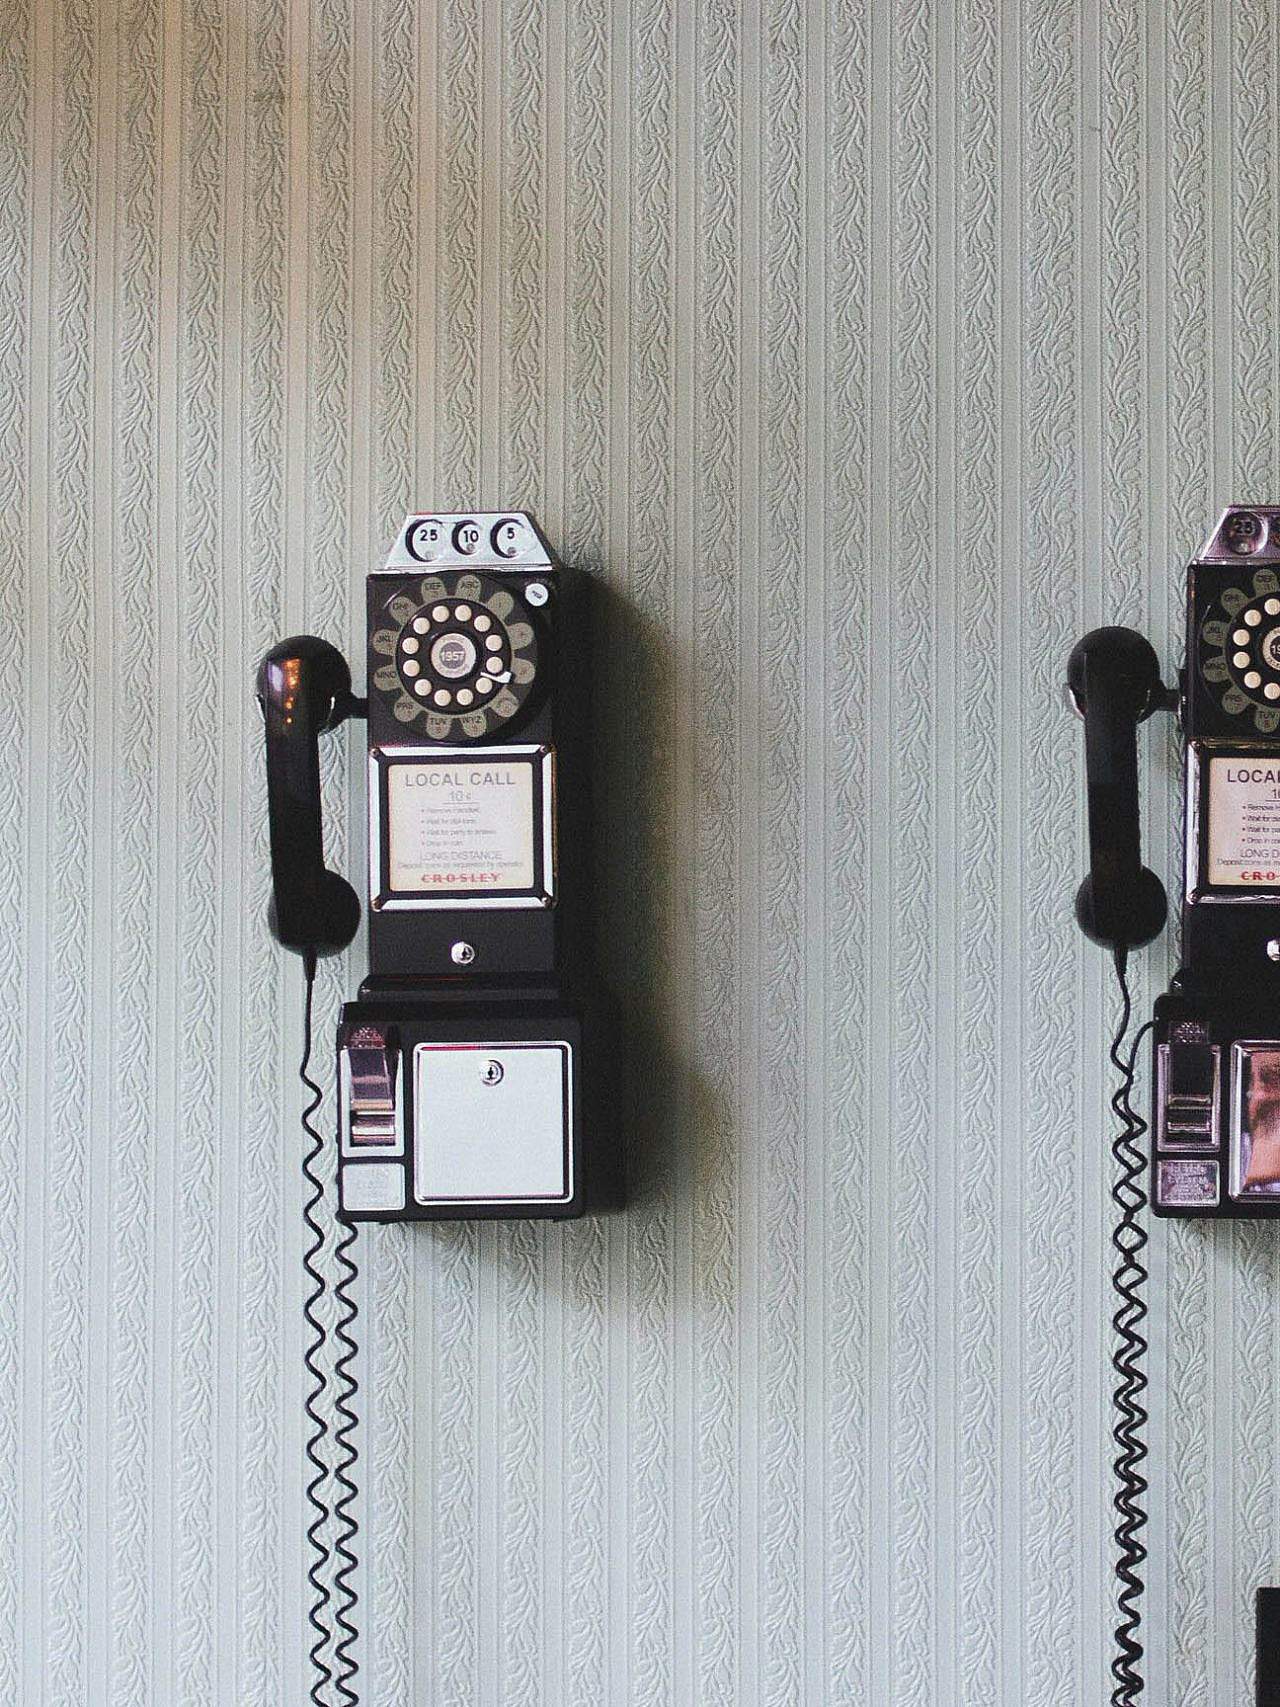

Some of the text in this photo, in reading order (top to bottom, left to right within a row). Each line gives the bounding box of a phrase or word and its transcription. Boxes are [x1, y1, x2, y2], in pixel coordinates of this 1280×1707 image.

[420, 527, 515, 543] 25 10 5
[405, 772, 516, 787] LOCAL CALL
[451, 851, 503, 860] DISTANCE
[1241, 849, 1269, 858] LONG
[421, 873, 502, 883] CROSLEY
